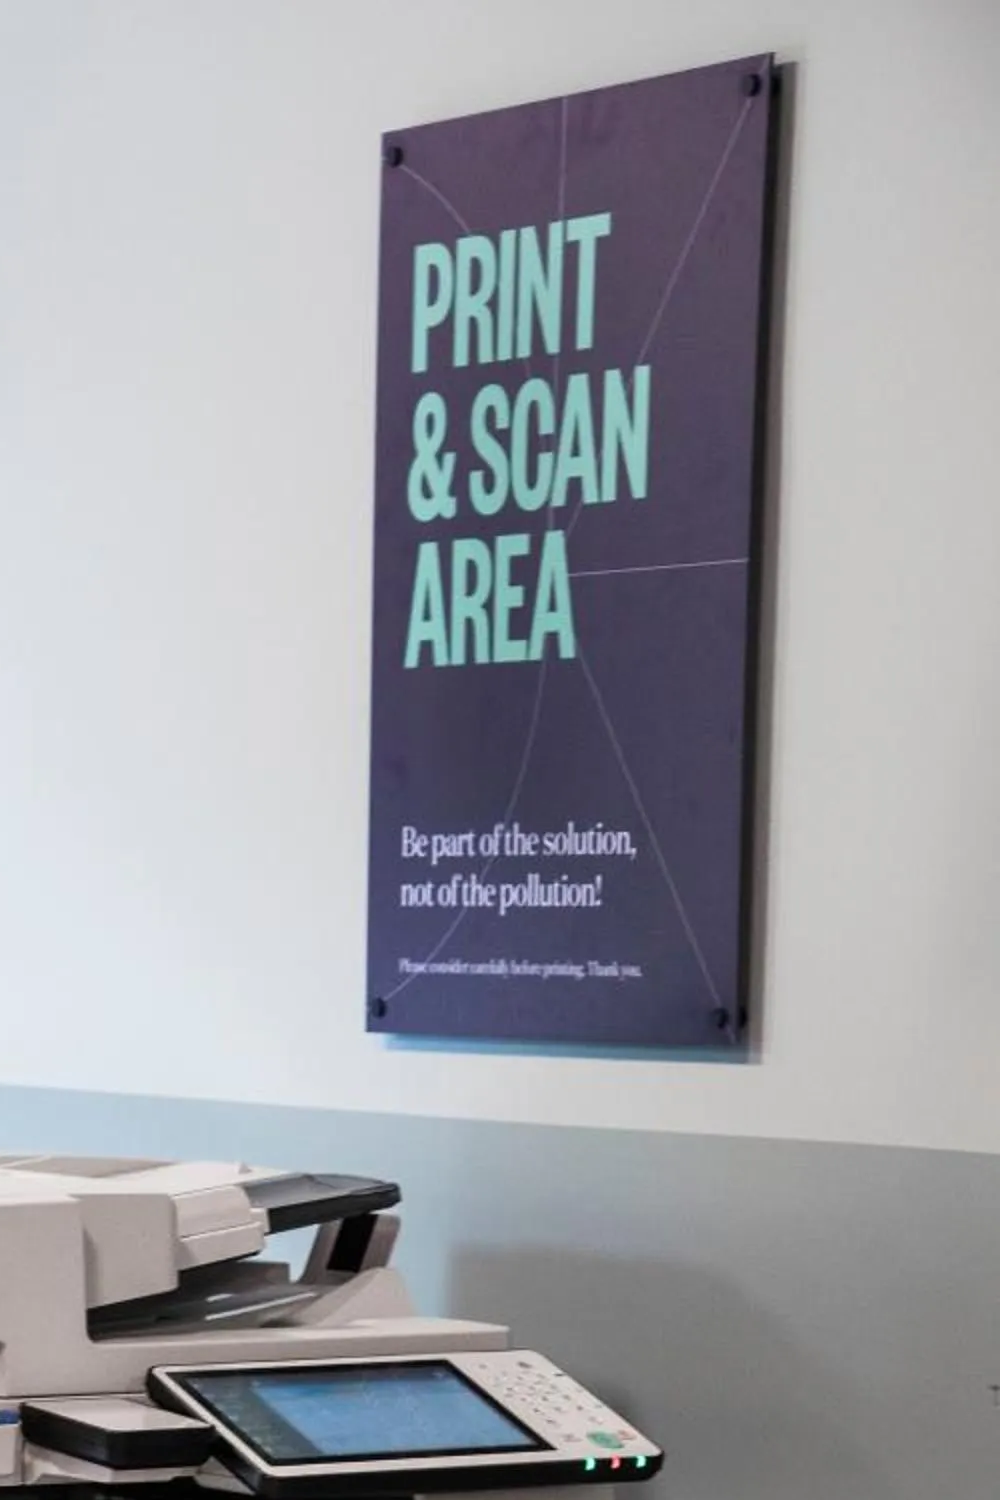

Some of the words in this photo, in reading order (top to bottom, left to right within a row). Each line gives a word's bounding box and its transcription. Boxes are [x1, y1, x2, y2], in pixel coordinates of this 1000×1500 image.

[411, 211, 611, 374] PRINT
[407, 391, 457, 522] &
[468, 364, 651, 516] SCAN
[404, 529, 576, 669] AREA
[400, 880, 434, 907] not
[437, 873, 462, 906] of
[462, 873, 496, 906] the
[499, 873, 603, 916] pollution!
[401, 826, 428, 857] Be
[431, 830, 475, 866] part
[479, 823, 504, 857] of
[504, 821, 539, 856] the
[543, 821, 637, 860] solution,
